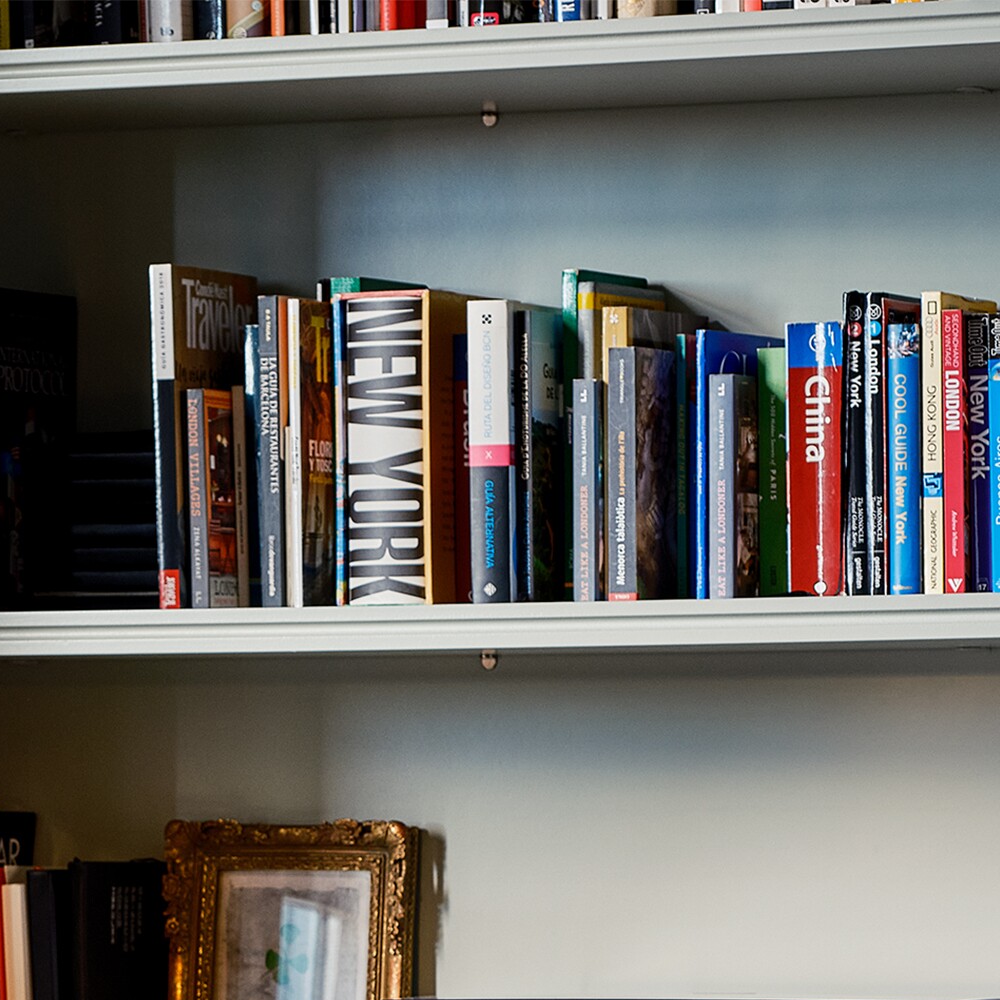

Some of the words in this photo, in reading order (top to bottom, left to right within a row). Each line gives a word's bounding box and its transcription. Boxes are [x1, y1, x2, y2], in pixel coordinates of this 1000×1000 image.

[481, 330, 491, 352] BCN
[944, 315, 952, 333] AND
[951, 313, 960, 368] SECONDHAND
[260, 358, 270, 372] DE
[268, 357, 278, 370] LA
[347, 301, 425, 429] NEW
[849, 340, 861, 373] New
[869, 339, 882, 395] London
[944, 333, 952, 367] VINTAGE
[481, 353, 492, 390] DISEÑO
[260, 374, 270, 436] BARCELONA
[268, 400, 278, 414] DE
[482, 391, 492, 411] DEL
[849, 374, 862, 409] York
[893, 373, 907, 420] COOL
[926, 385, 938, 421] KONG
[945, 370, 961, 432] LONDON
[969, 374, 989, 426] New
[187, 398, 200, 447] LONDON
[482, 412, 493, 438] RUTA
[805, 375, 831, 464] China
[269, 415, 279, 494] RESTAURANTES
[893, 423, 908, 472] GUIDE
[926, 424, 938, 461] HONG
[970, 428, 990, 481] York
[189, 452, 202, 517] VILLAGES
[484, 479, 496, 504] GUÍA
[769, 469, 777, 501] PARIS
[895, 475, 908, 508] New
[580, 484, 588, 539] LONDONER
[717, 479, 726, 534] LONDONER
[876, 506, 884, 543] MONOCLE
[348, 450, 428, 604] YORK
[484, 506, 496, 569] ALTERNATIVA
[717, 535, 726, 544] A
[857, 507, 865, 544] MONOCLE
[895, 510, 908, 545] York
[930, 509, 938, 554] GEOGRAPHIC
[580, 541, 588, 549] A
[717, 546, 726, 573] LIKE
[580, 551, 588, 578] LIKE
[616, 543, 626, 585] Menorca
[930, 556, 938, 590] NATIONAL
[580, 580, 588, 601] EAT
[717, 575, 726, 597] EAT
[978, 583, 987, 592] 17
